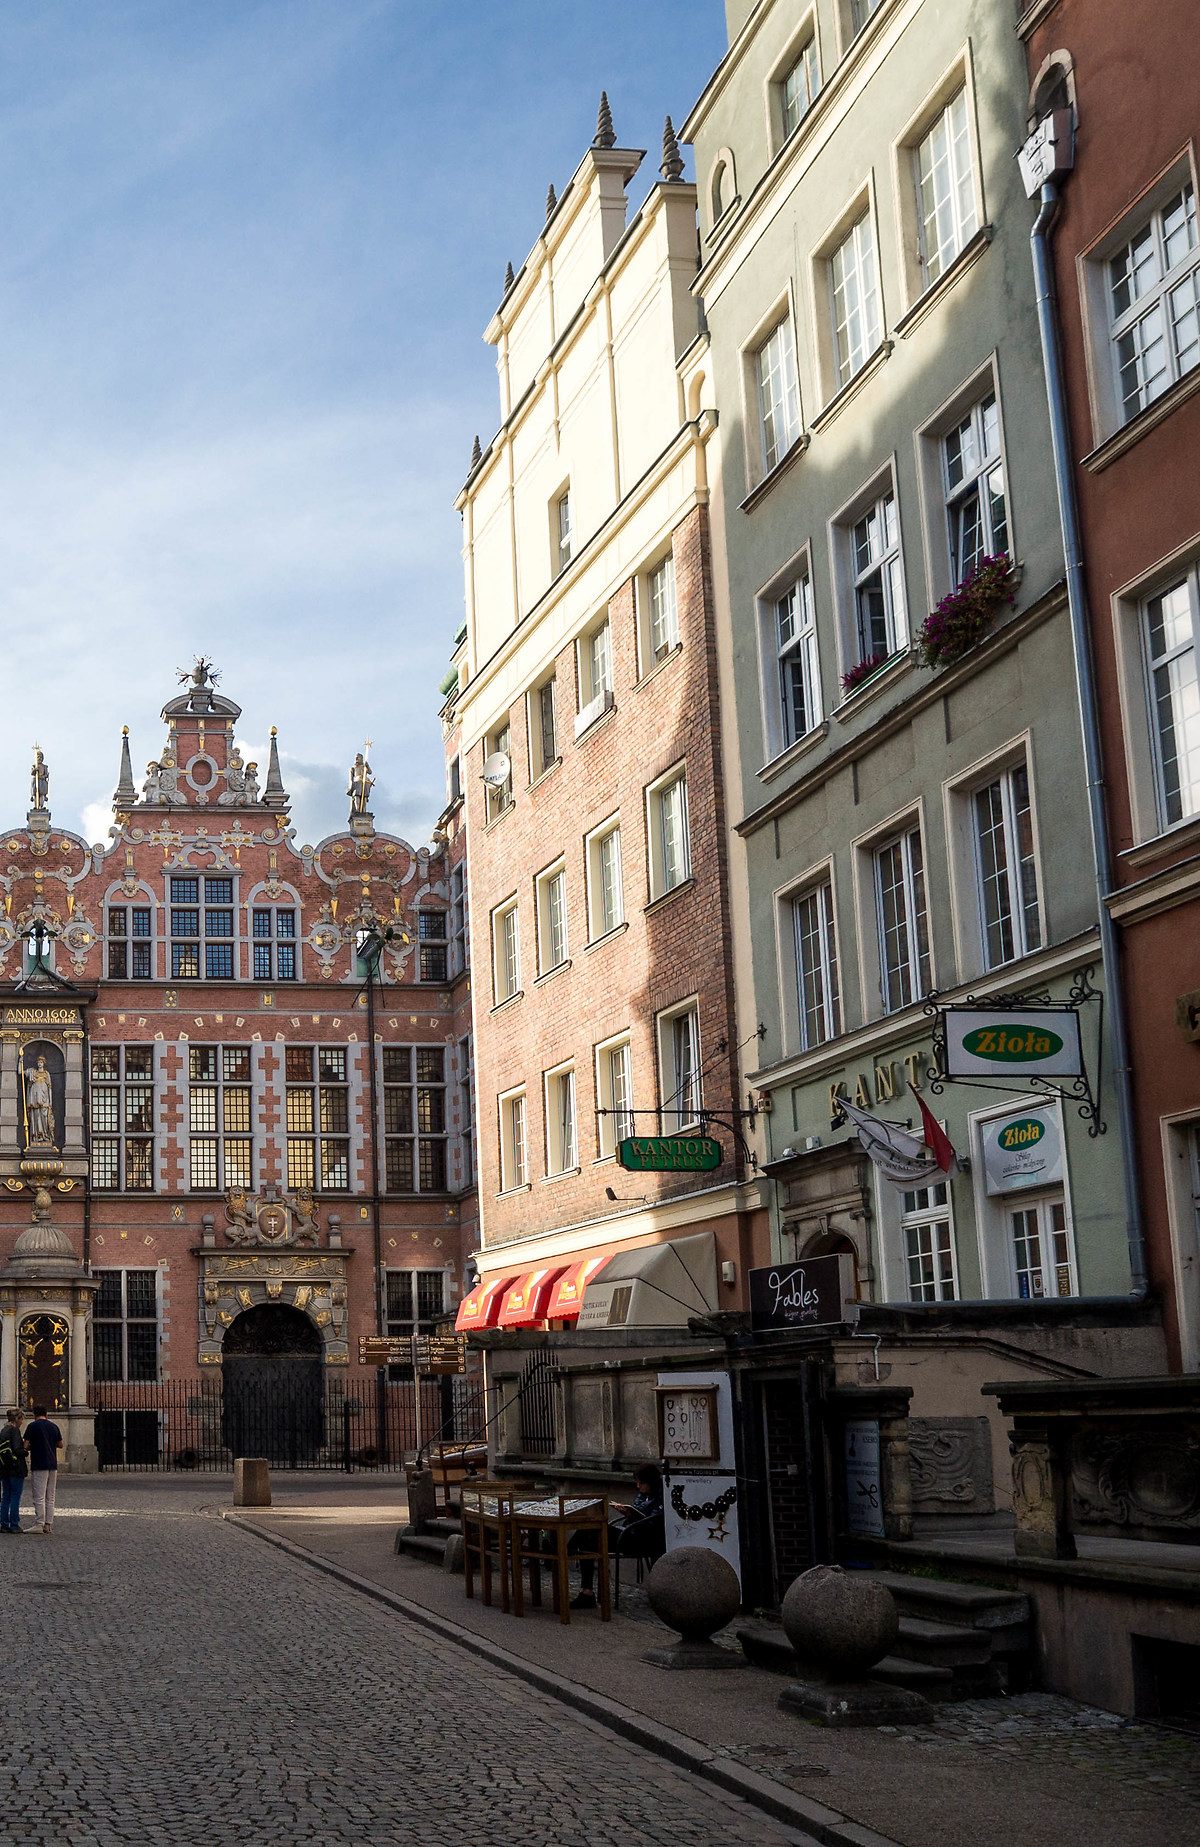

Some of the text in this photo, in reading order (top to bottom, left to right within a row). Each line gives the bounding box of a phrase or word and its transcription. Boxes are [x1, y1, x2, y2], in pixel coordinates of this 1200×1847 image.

[6, 1008, 43, 1019] ANNO
[975, 1031, 1050, 1054] Zioła
[827, 1050, 945, 1118] KANT
[1004, 1123, 1040, 1147] Zioła
[631, 1140, 713, 1156] KANTOR
[640, 1155, 703, 1167] PETRUS
[768, 1268, 819, 1315] Fables
